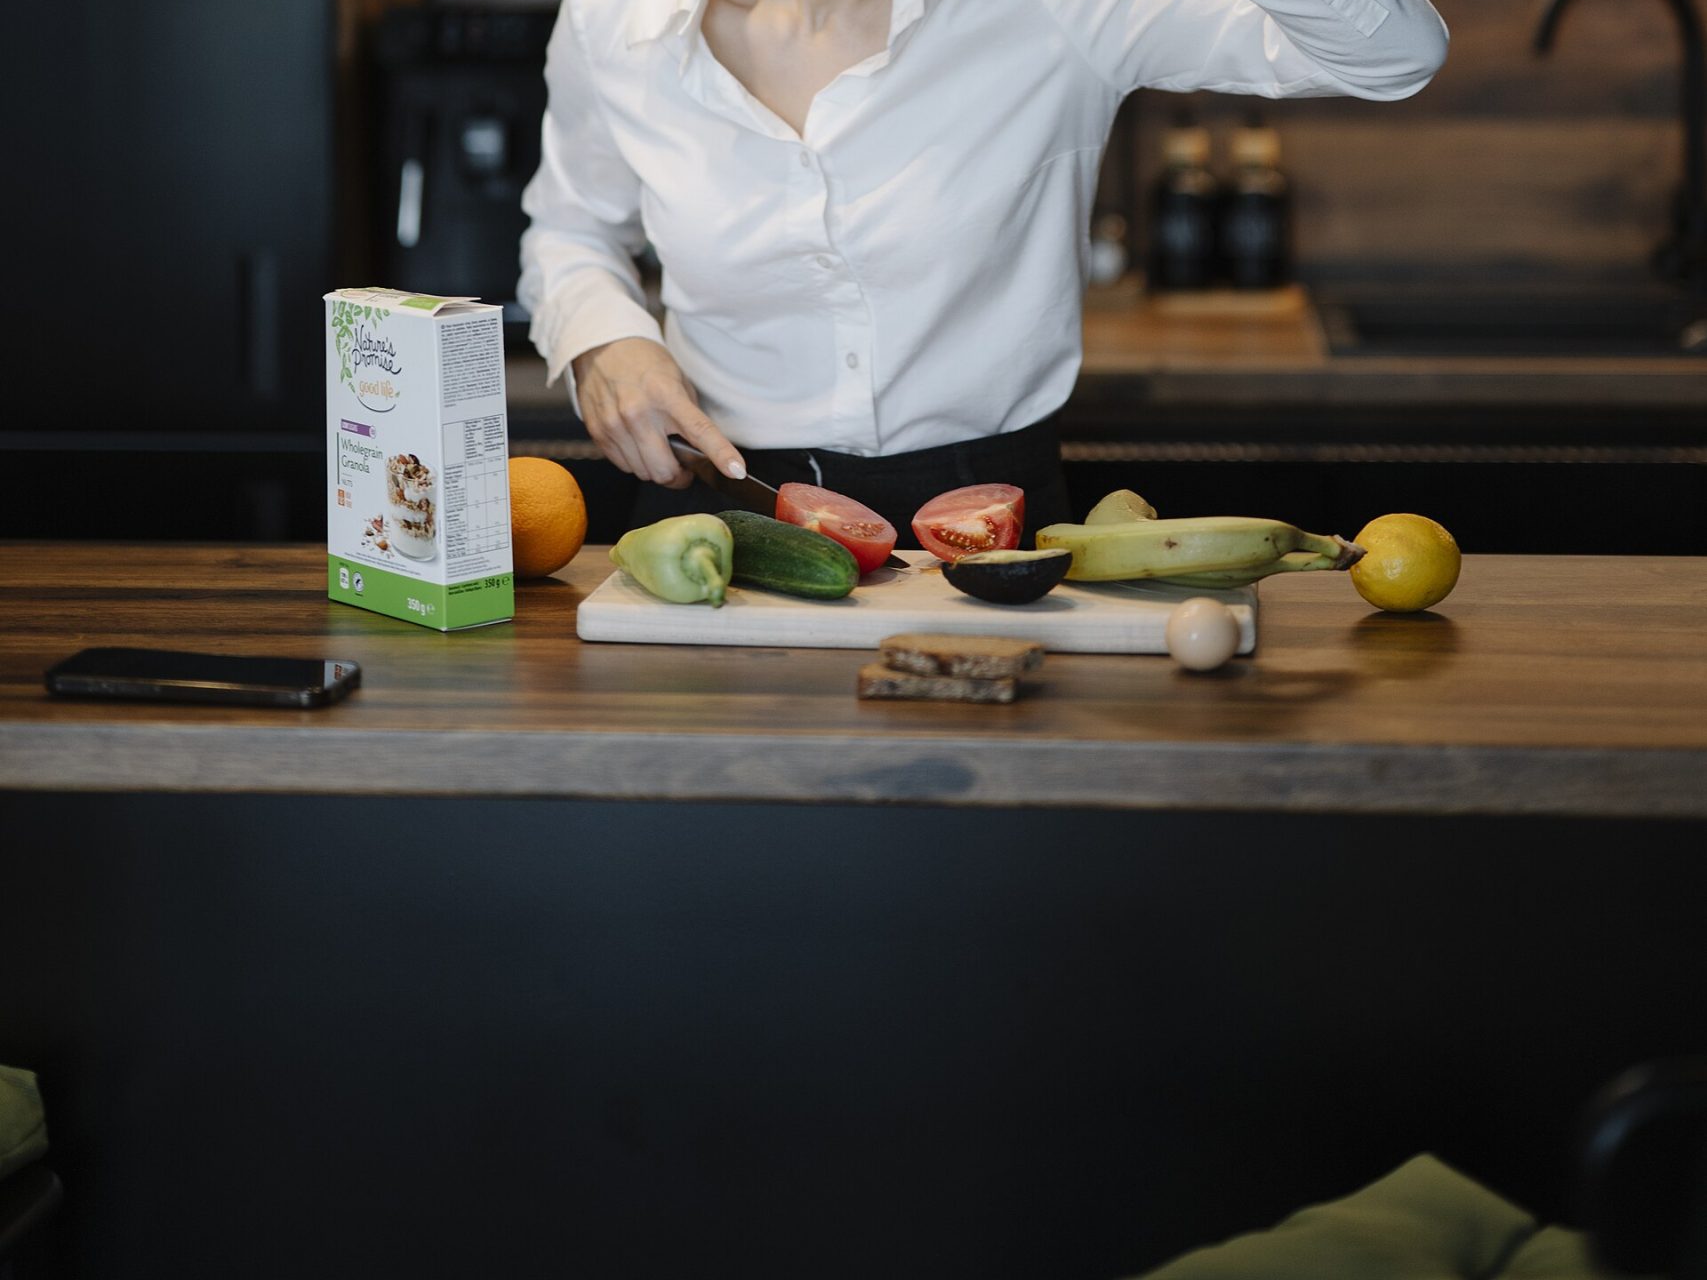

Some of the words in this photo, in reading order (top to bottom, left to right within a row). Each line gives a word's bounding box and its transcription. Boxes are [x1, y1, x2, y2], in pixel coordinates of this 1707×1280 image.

[354, 325, 396, 357] Nature's
[352, 348, 402, 375] Promise
[359, 381, 379, 397] good
[381, 380, 394, 400] life
[341, 437, 384, 460] Wholegrain
[341, 454, 371, 474] Granola
[484, 578, 496, 589] 350
[407, 597, 420, 611] 350
